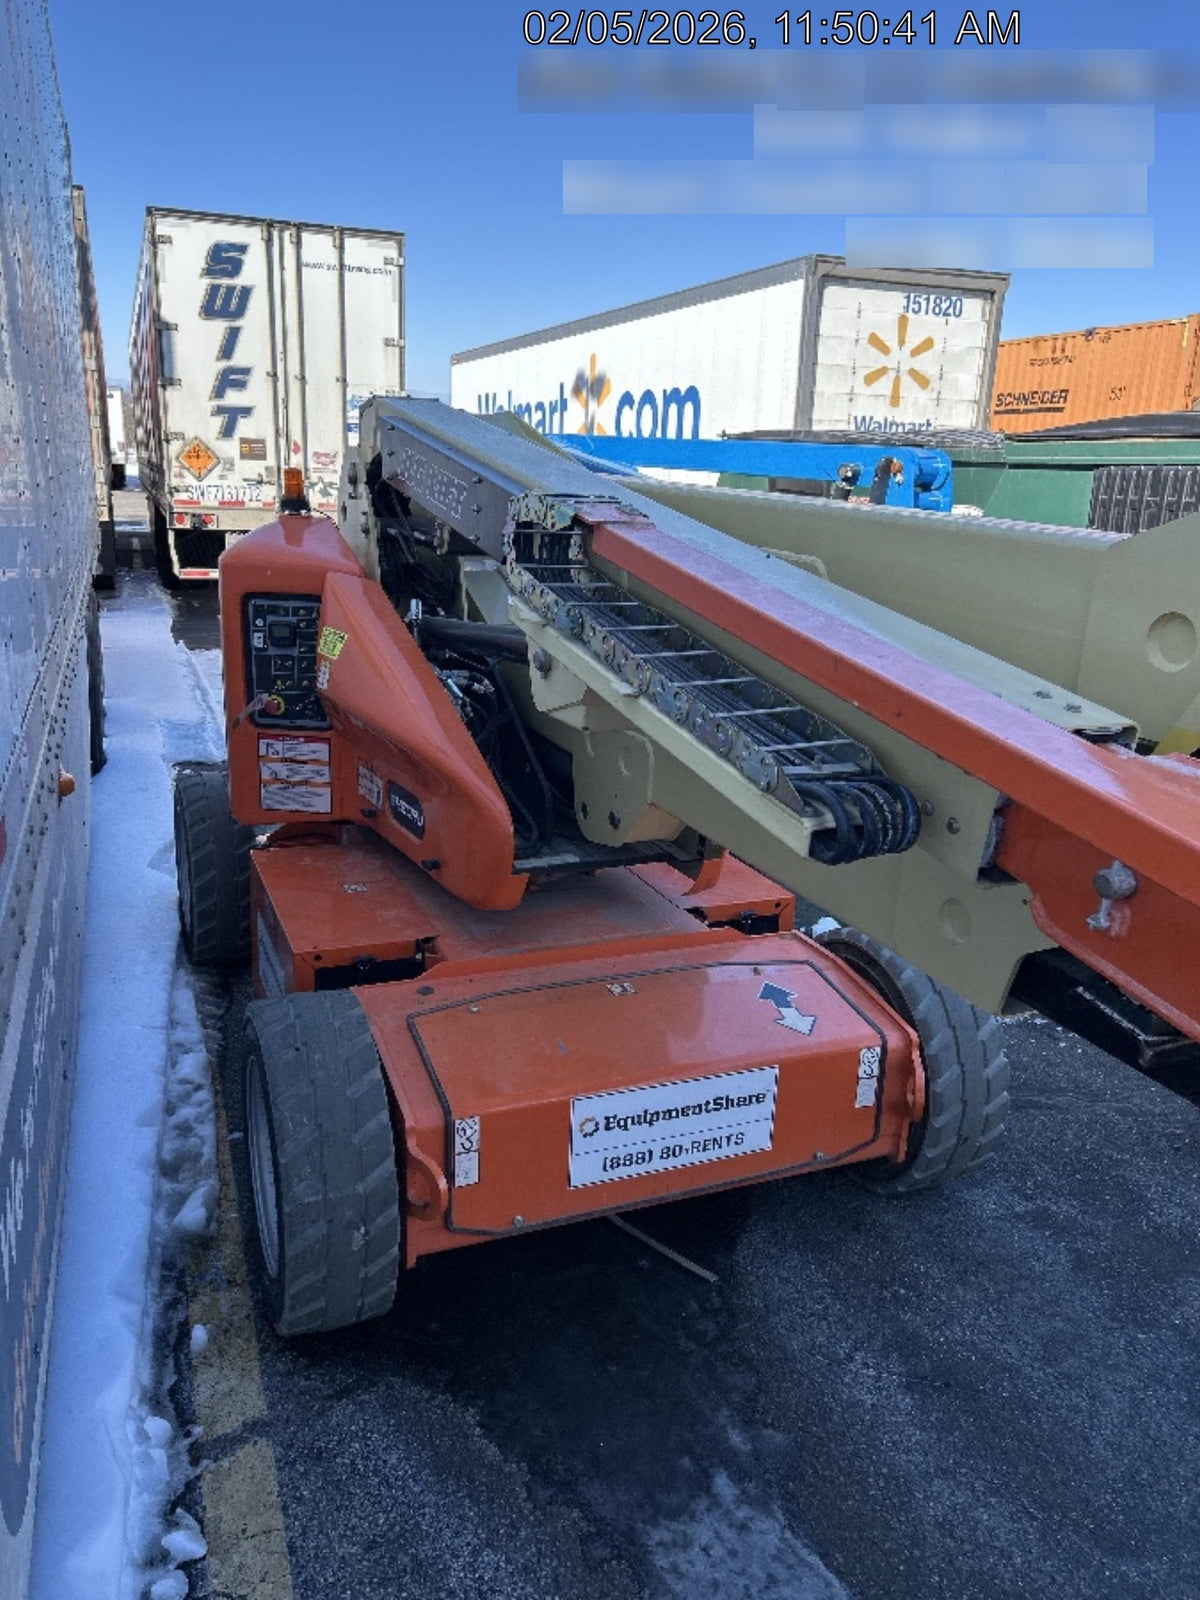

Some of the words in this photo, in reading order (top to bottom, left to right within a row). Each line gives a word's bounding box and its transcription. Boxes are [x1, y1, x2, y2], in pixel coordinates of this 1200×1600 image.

[902, 293, 964, 319] 151820
[199, 239, 255, 440] SWIFT
[995, 389, 1070, 408] SCHNEIDER
[853, 415, 933, 433] Walmart
[603, 1092, 766, 1131] EquipmentShare
[602, 1150, 654, 1172] (888)
